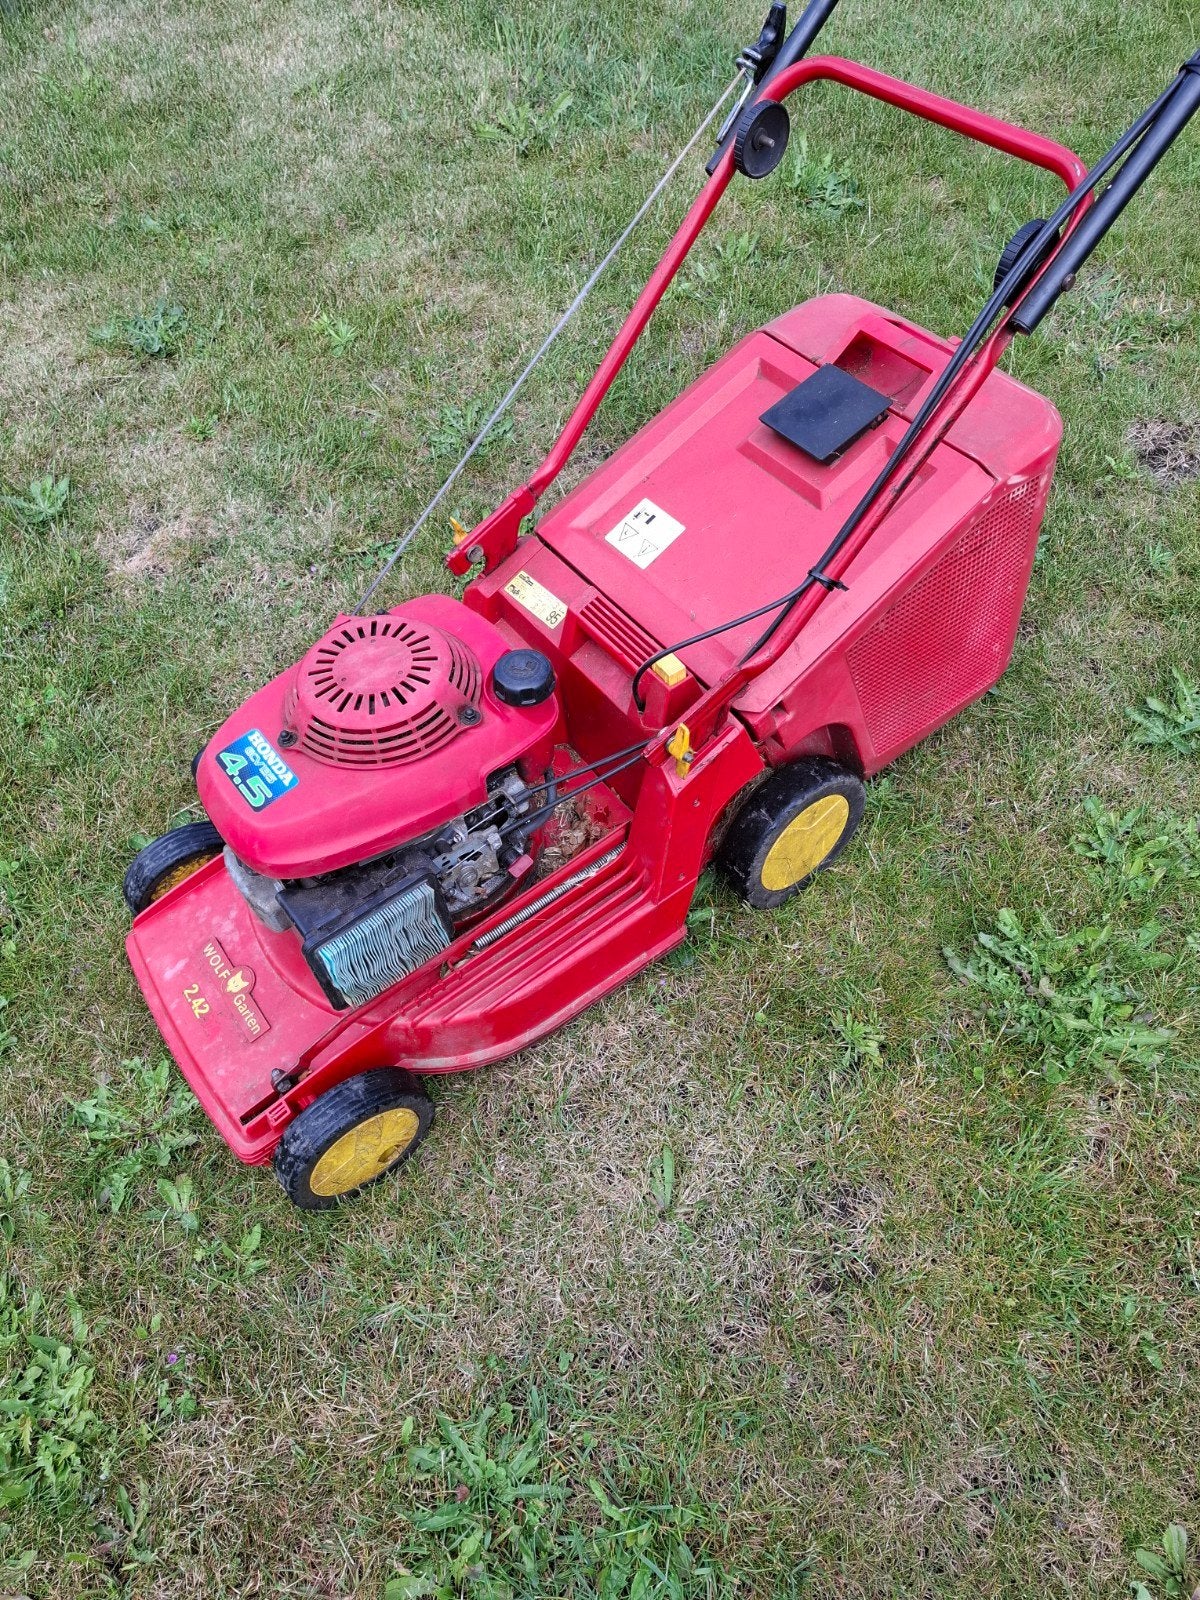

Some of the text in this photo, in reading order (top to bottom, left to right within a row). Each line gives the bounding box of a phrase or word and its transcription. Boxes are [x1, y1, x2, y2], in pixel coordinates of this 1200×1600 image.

[219, 752, 273, 807] 4.5
[248, 731, 294, 787] HONDA
[203, 943, 261, 1035] WOLF Garten
